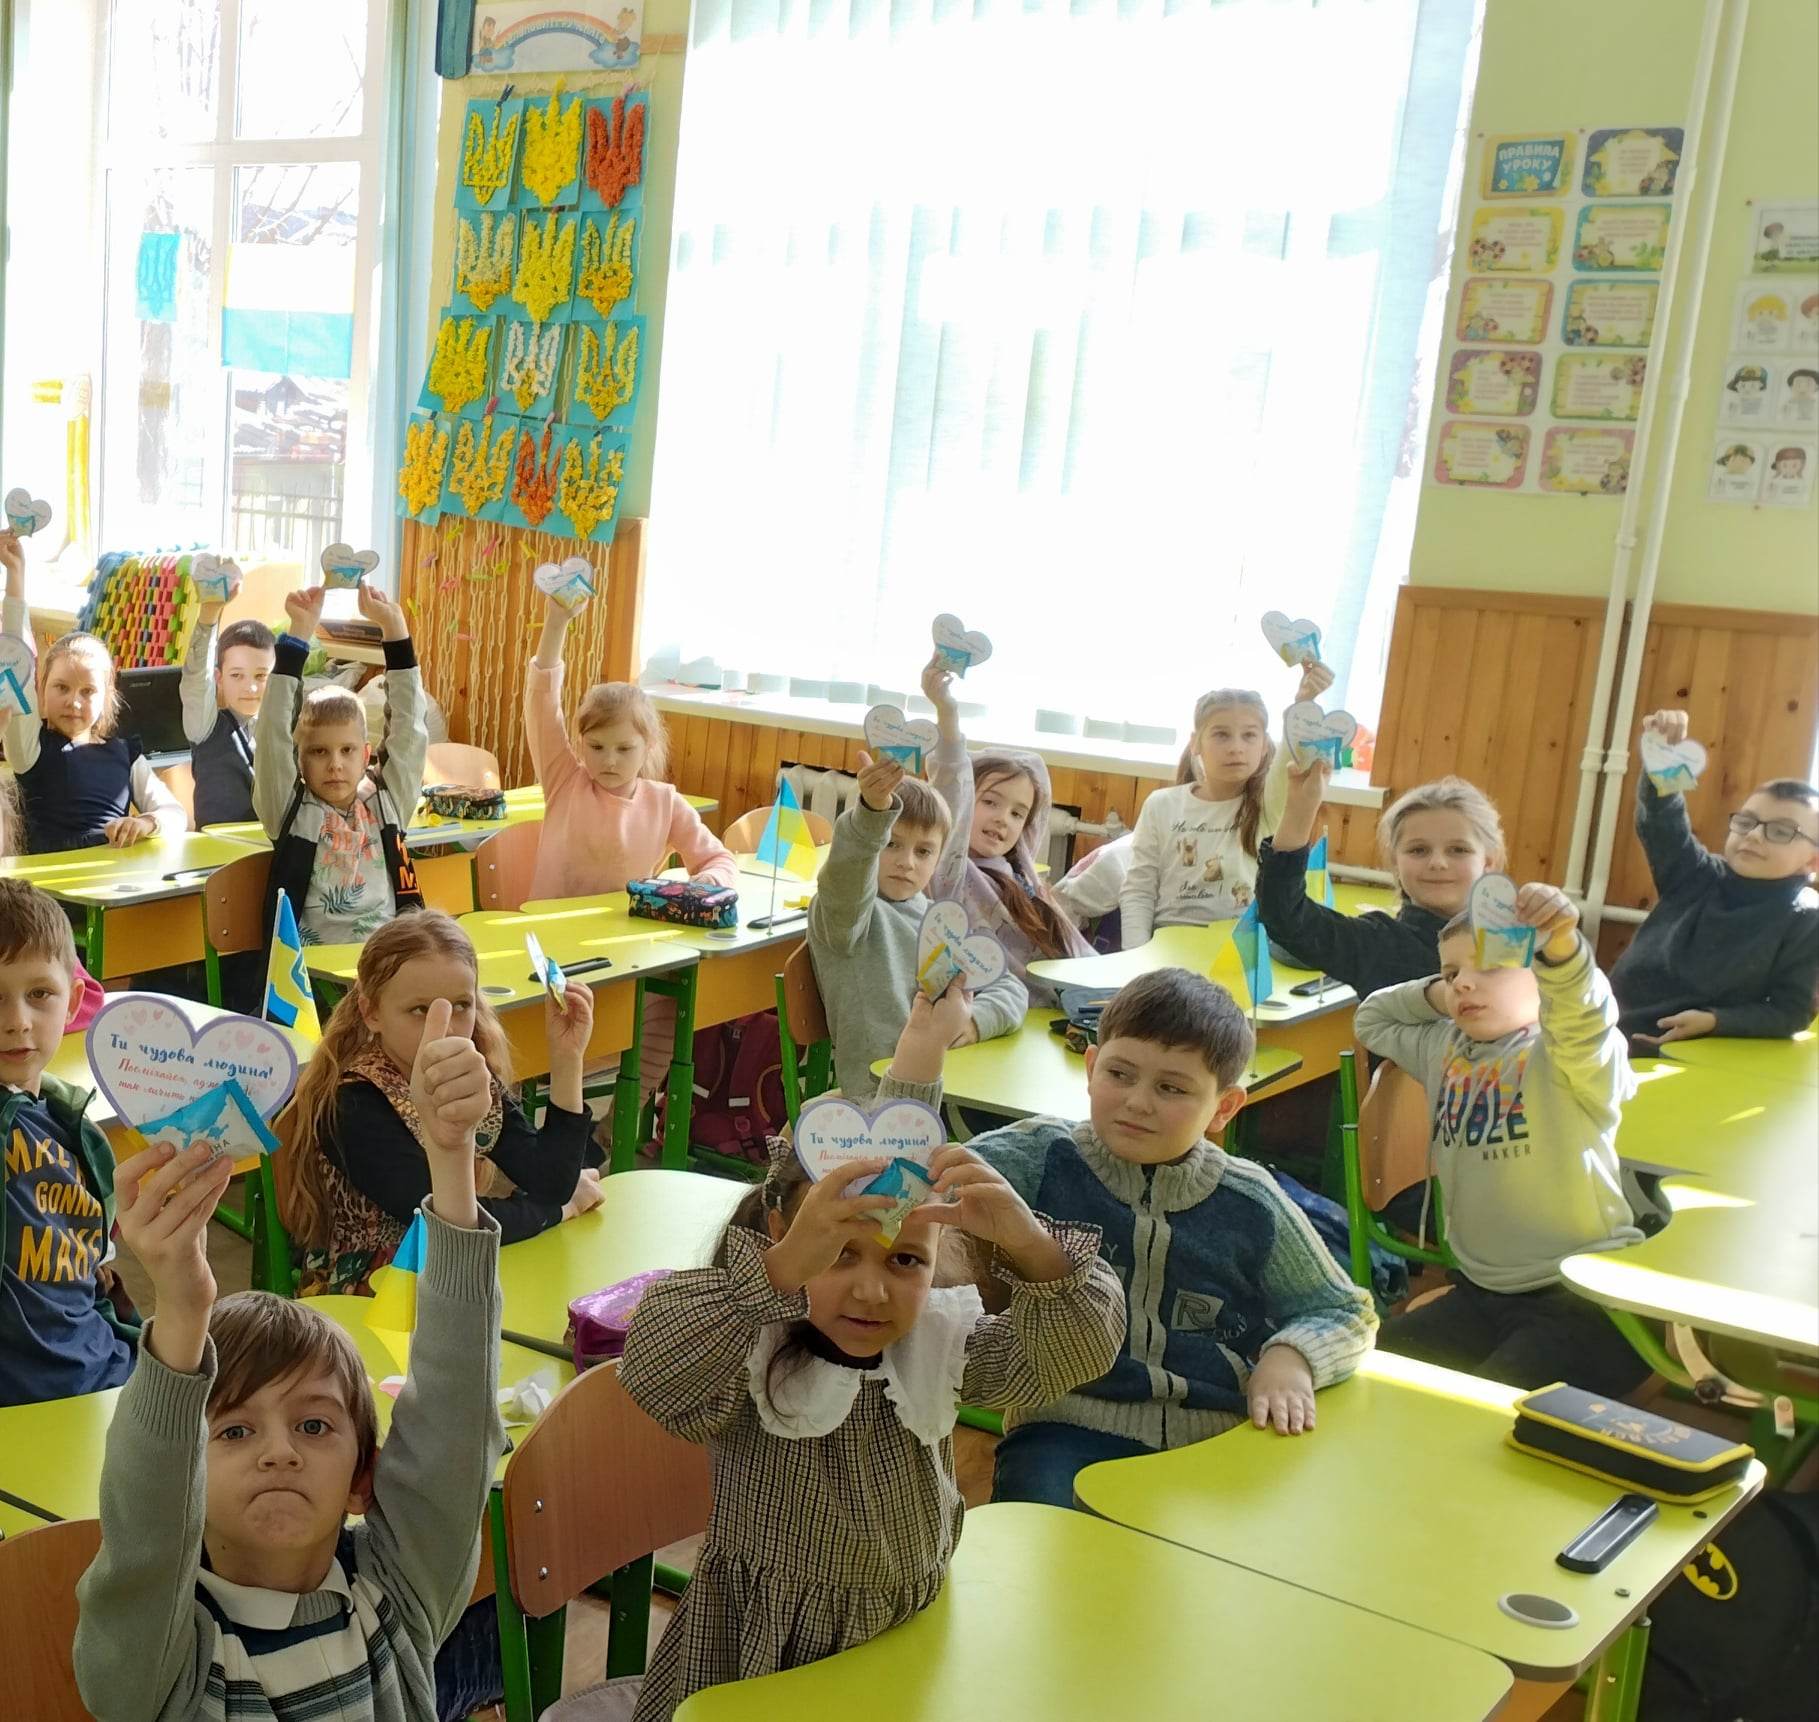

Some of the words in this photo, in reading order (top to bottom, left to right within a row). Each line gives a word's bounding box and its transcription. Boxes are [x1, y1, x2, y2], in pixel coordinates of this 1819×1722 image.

[1499, 145, 1560, 160] ПРАВИЛА
[1502, 159, 1552, 173] УРОКУ
[110, 1033, 127, 1050] Ти
[139, 1043, 195, 1065] чудова
[203, 1060, 273, 1080] людина!
[810, 1132, 824, 1145] Ти
[831, 1133, 873, 1149] чудова
[879, 1135, 930, 1149] людина!
